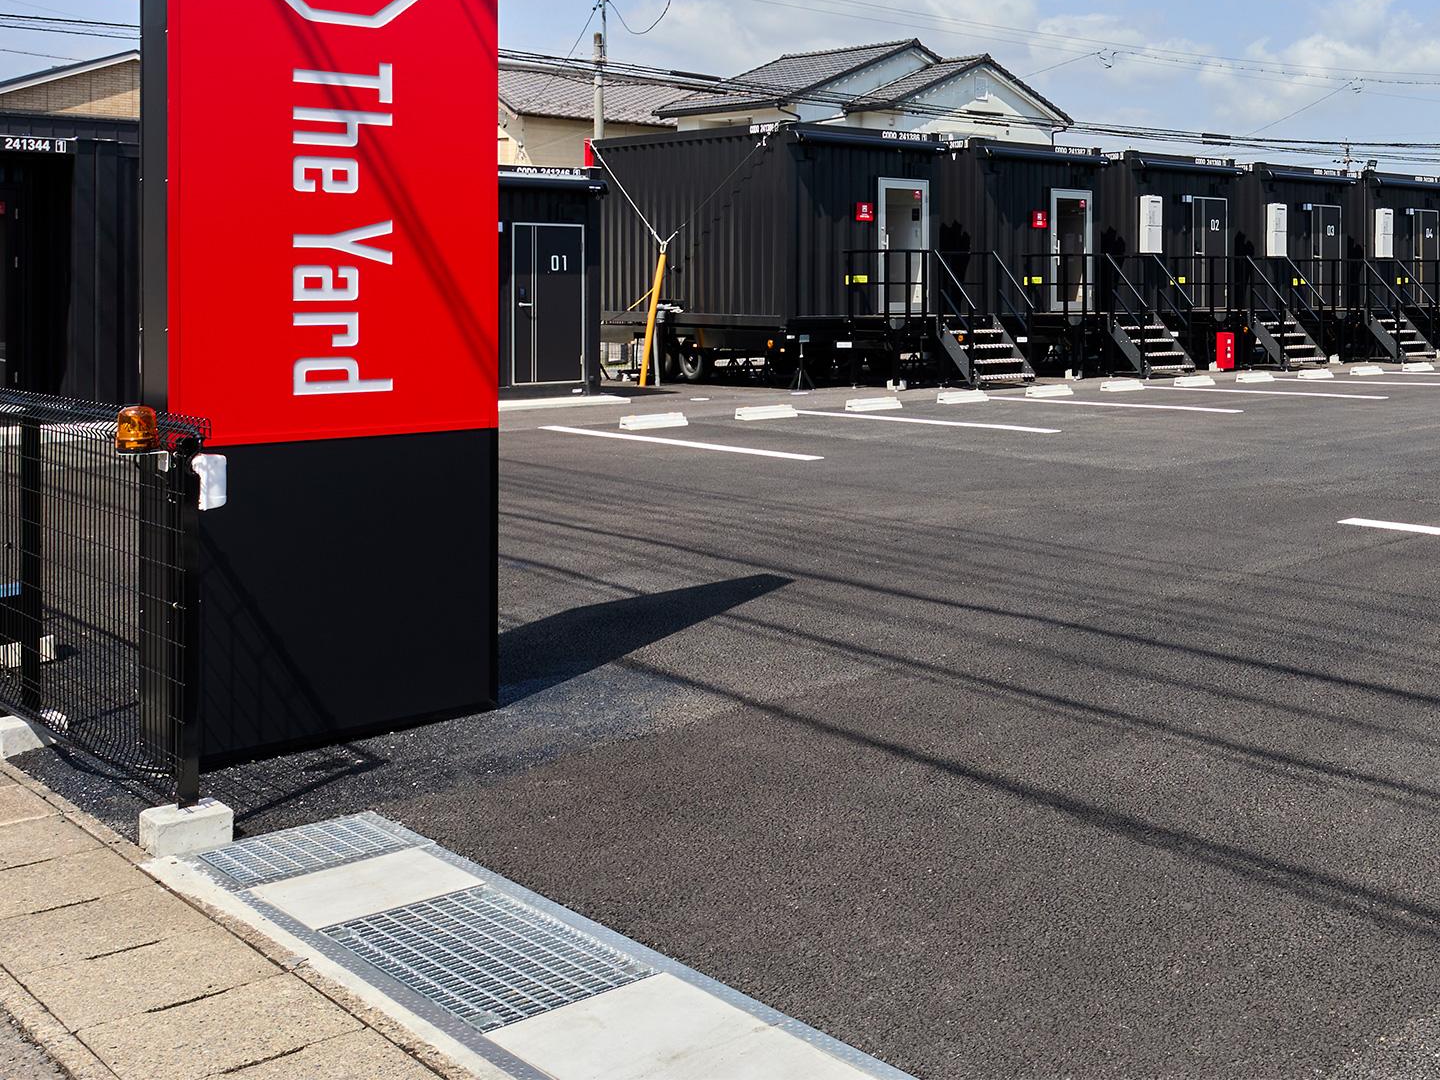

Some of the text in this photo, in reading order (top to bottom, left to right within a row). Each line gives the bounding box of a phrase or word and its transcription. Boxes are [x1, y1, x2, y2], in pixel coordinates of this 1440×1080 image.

[292, 63, 394, 194] The
[4, 137, 51, 152] 241344
[1210, 219, 1220, 231] 02
[551, 255, 567, 271] 01
[292, 219, 394, 396] Yard
